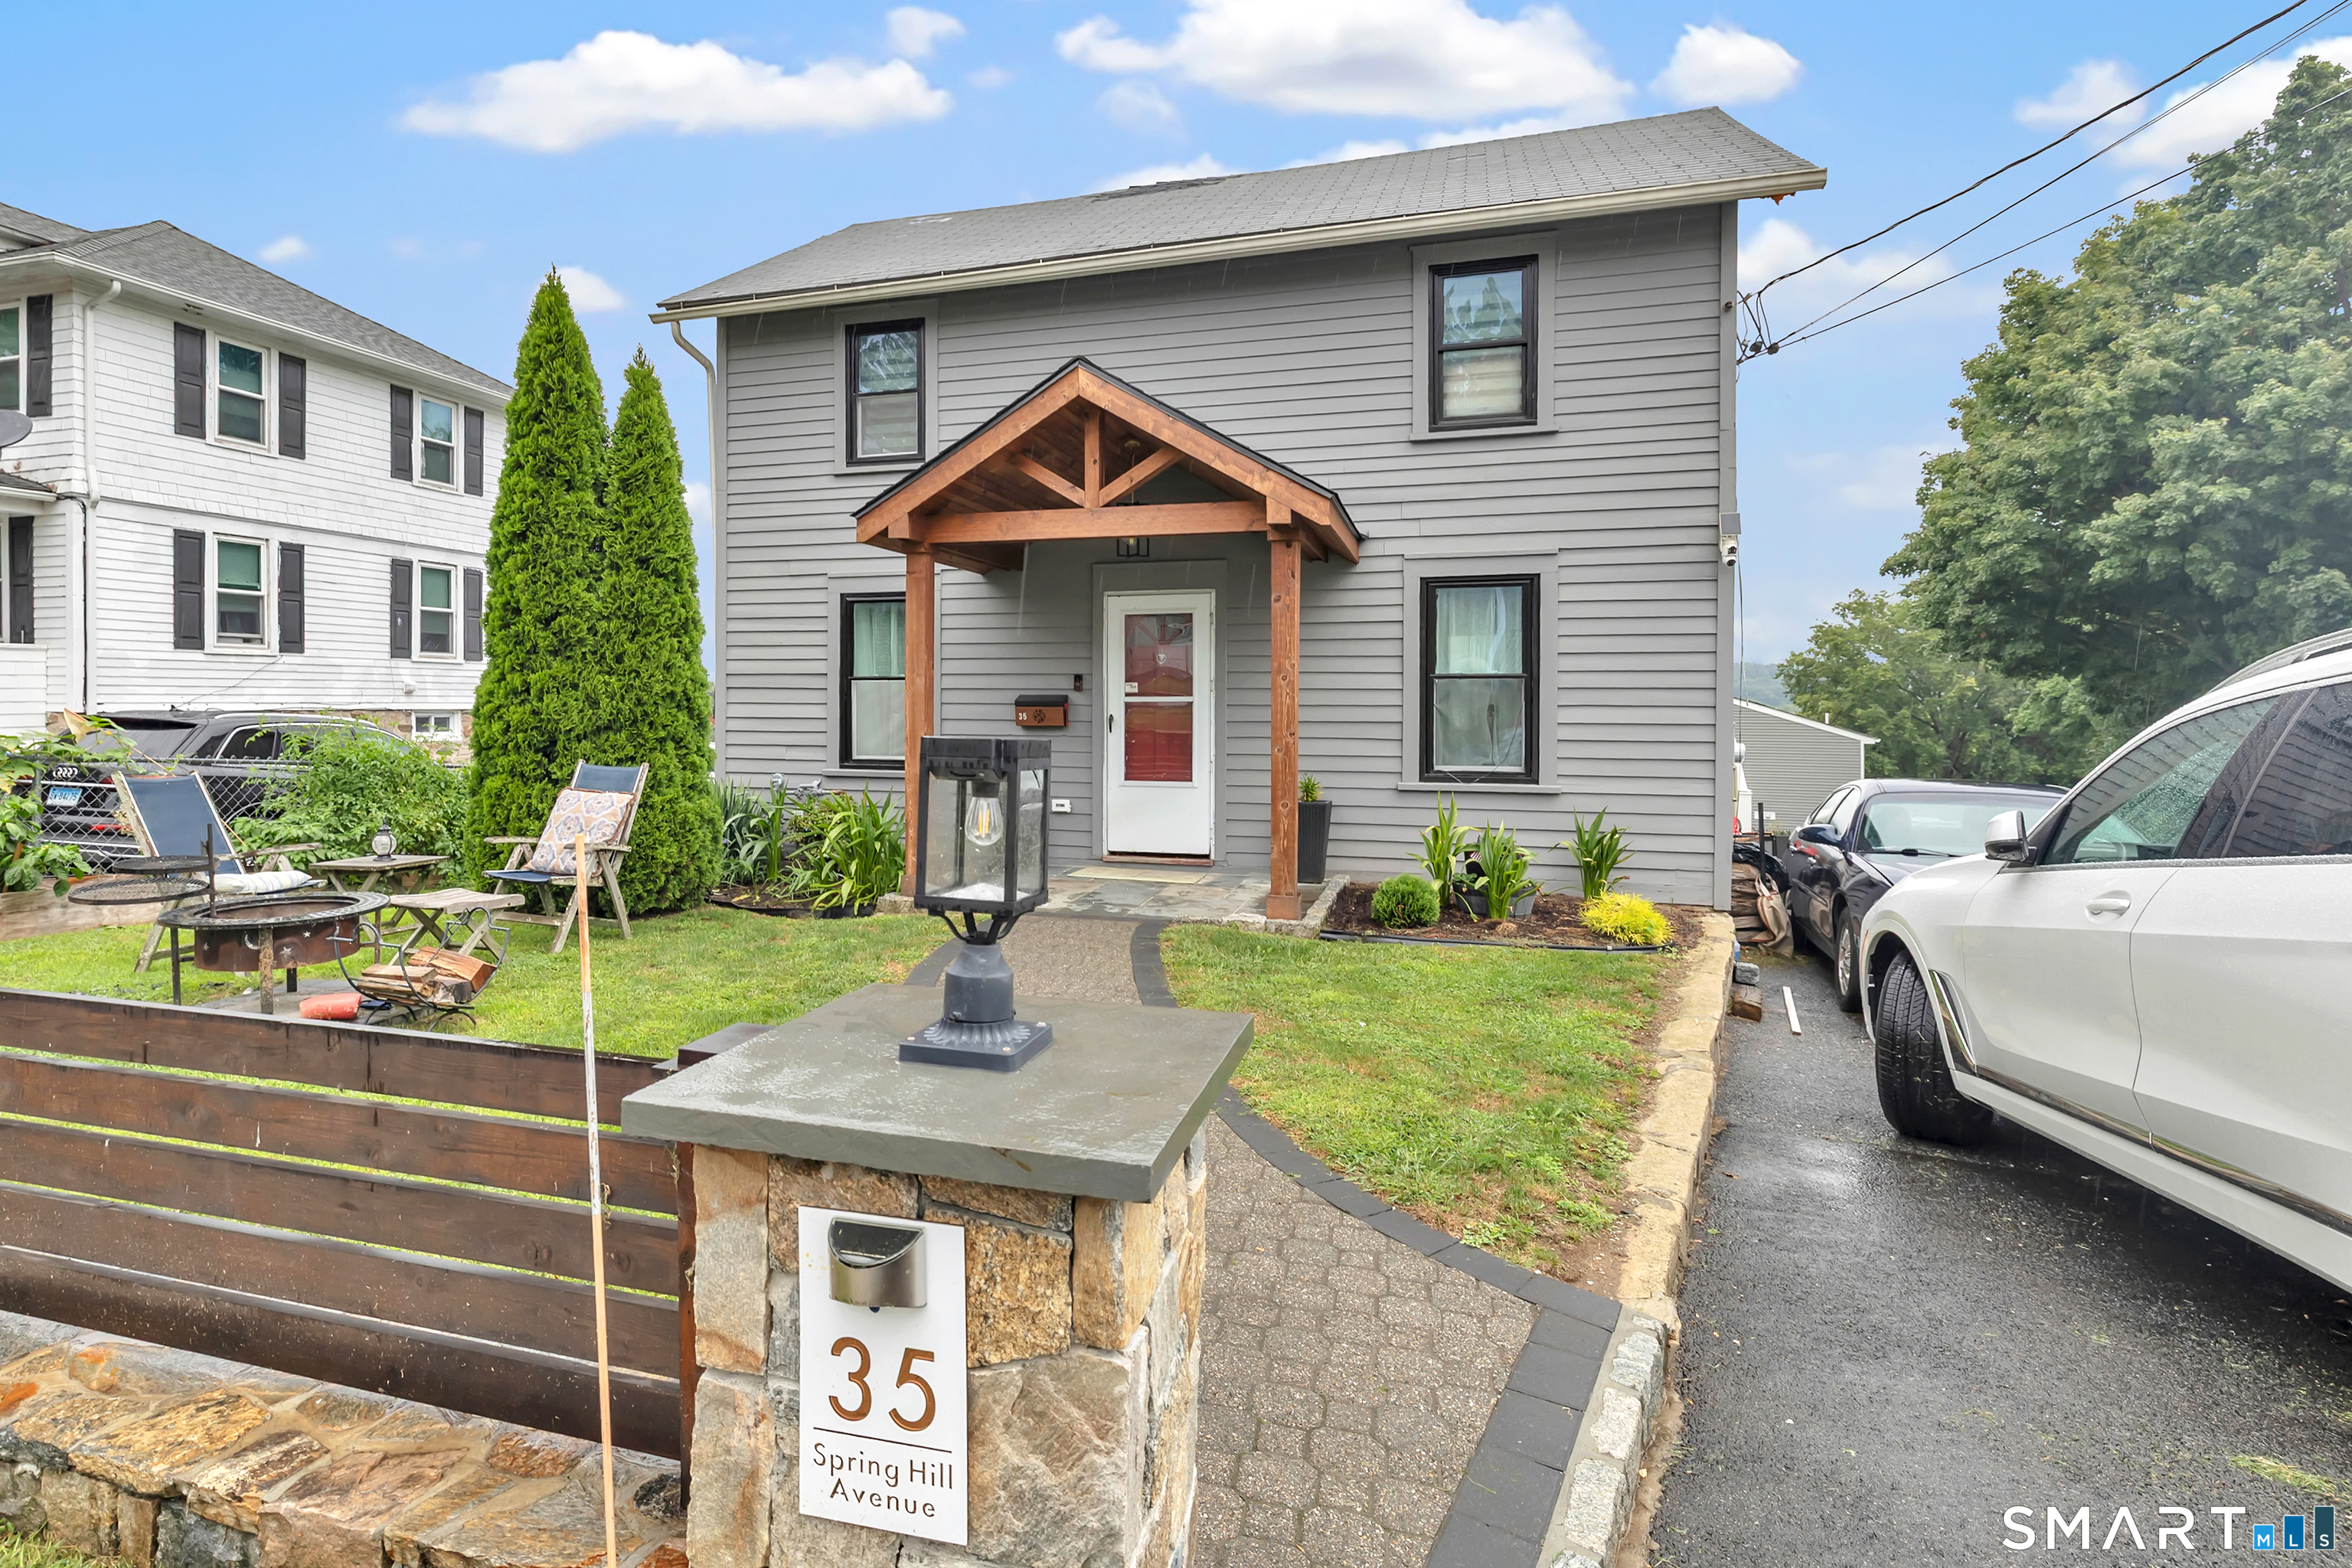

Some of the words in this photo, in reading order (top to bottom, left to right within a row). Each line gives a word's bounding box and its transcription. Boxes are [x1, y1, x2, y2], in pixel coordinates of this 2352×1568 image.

[1018, 712, 1027, 720] 35
[829, 1337, 936, 1432] 35
[813, 1443, 899, 1487] Spring
[910, 1460, 953, 1489] Hill
[830, 1478, 936, 1517] Avenue
